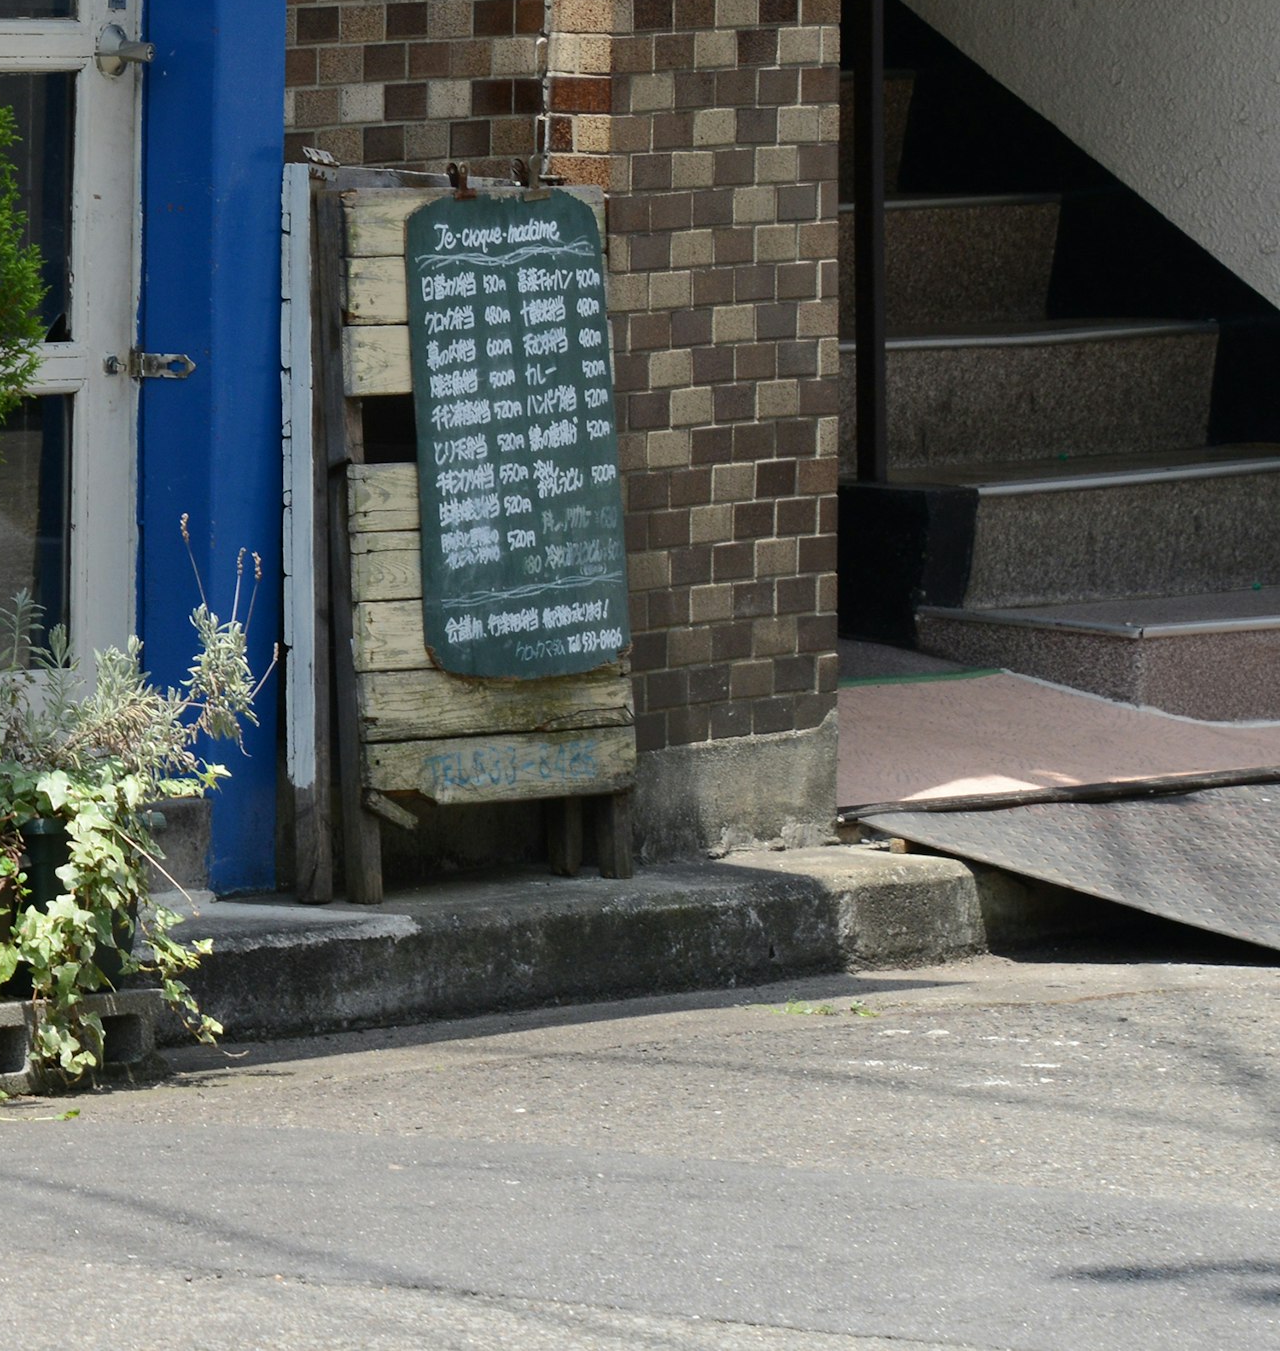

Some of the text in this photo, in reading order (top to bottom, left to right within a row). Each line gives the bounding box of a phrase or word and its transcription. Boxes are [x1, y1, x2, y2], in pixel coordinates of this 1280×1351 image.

[576, 268, 600, 289] 500円
[484, 306, 510, 325] 480円
[577, 297, 600, 318] 480円
[486, 338, 512, 357] 600円
[579, 328, 601, 348] 480円
[489, 368, 515, 388] 500円
[525, 359, 606, 386] カレー 500円
[585, 388, 608, 408] 520円
[494, 400, 522, 420] 520円
[586, 420, 610, 441] 520円
[434, 432, 525, 465] とり天弁当 520円
[500, 463, 528, 483] 550円
[504, 495, 532, 517] 520円
[507, 530, 536, 552] 520円
